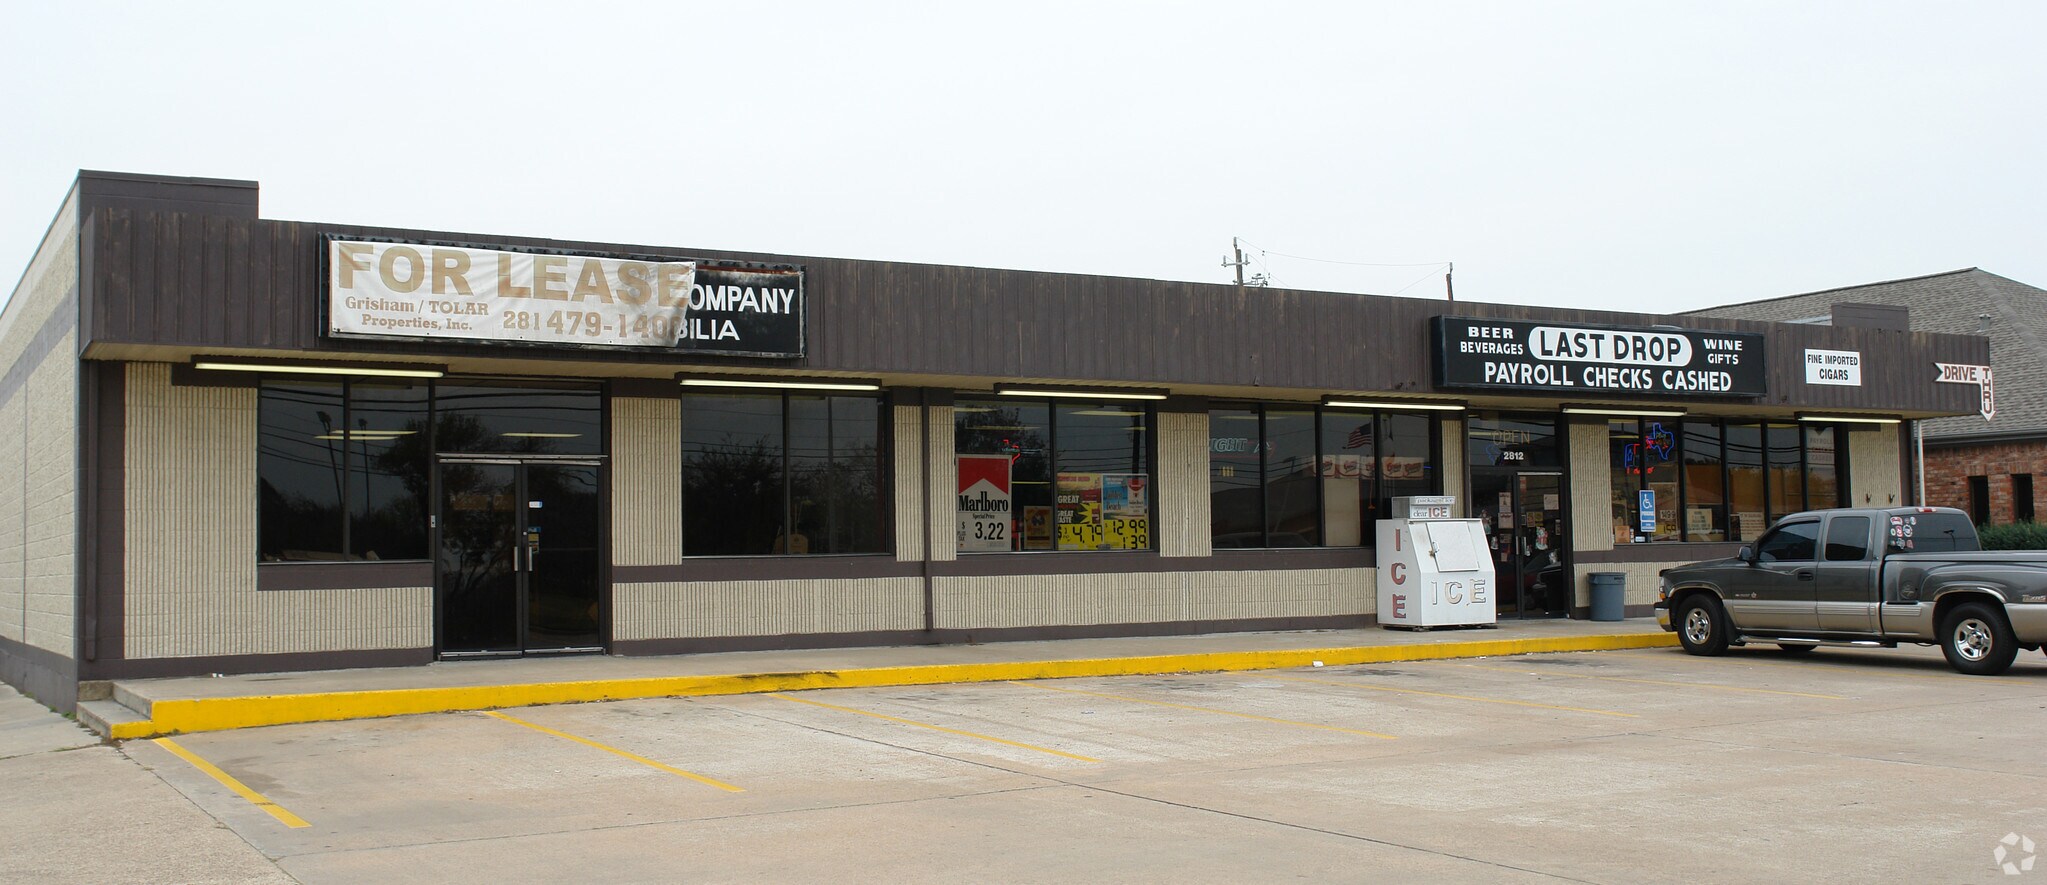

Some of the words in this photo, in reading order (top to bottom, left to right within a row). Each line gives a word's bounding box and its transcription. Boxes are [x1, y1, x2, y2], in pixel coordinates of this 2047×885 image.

[338, 242, 474, 296] FOR
[497, 253, 690, 308] LEASE
[345, 296, 414, 313] Grisham
[418, 300, 424, 314] /
[429, 300, 489, 316] TOLAR
[361, 313, 442, 330] Properties,
[446, 318, 473, 331] Inc.
[503, 310, 540, 331] 281
[1467, 326, 1514, 339] BEER
[1460, 341, 1524, 356] BEVERAGES
[1539, 330, 1606, 358] LAST
[1613, 335, 1682, 363] DROP
[1703, 338, 1743, 351] WINE
[1707, 353, 1739, 365] GIFTS
[1807, 354, 1823, 364] FINE
[1825, 355, 1859, 366] IMPORTED
[1484, 362, 1574, 387] PAYROLL
[1583, 366, 1653, 390] CHECKS
[1662, 370, 1732, 392] CASHED
[1819, 368, 1849, 381] CIGARS
[1944, 365, 1978, 382] DRIVE
[1982, 367, 1993, 414] THRU
[1492, 429, 1531, 446] OPEN
[1503, 451, 1525, 461] 2812
[958, 491, 1009, 512] Marlboro
[1057, 495, 1080, 504] GREAT
[1428, 506, 1448, 518] ICE
[975, 521, 1004, 540] 3.22
[1390, 528, 1407, 619] ICE
[1431, 579, 1487, 606] ICE
